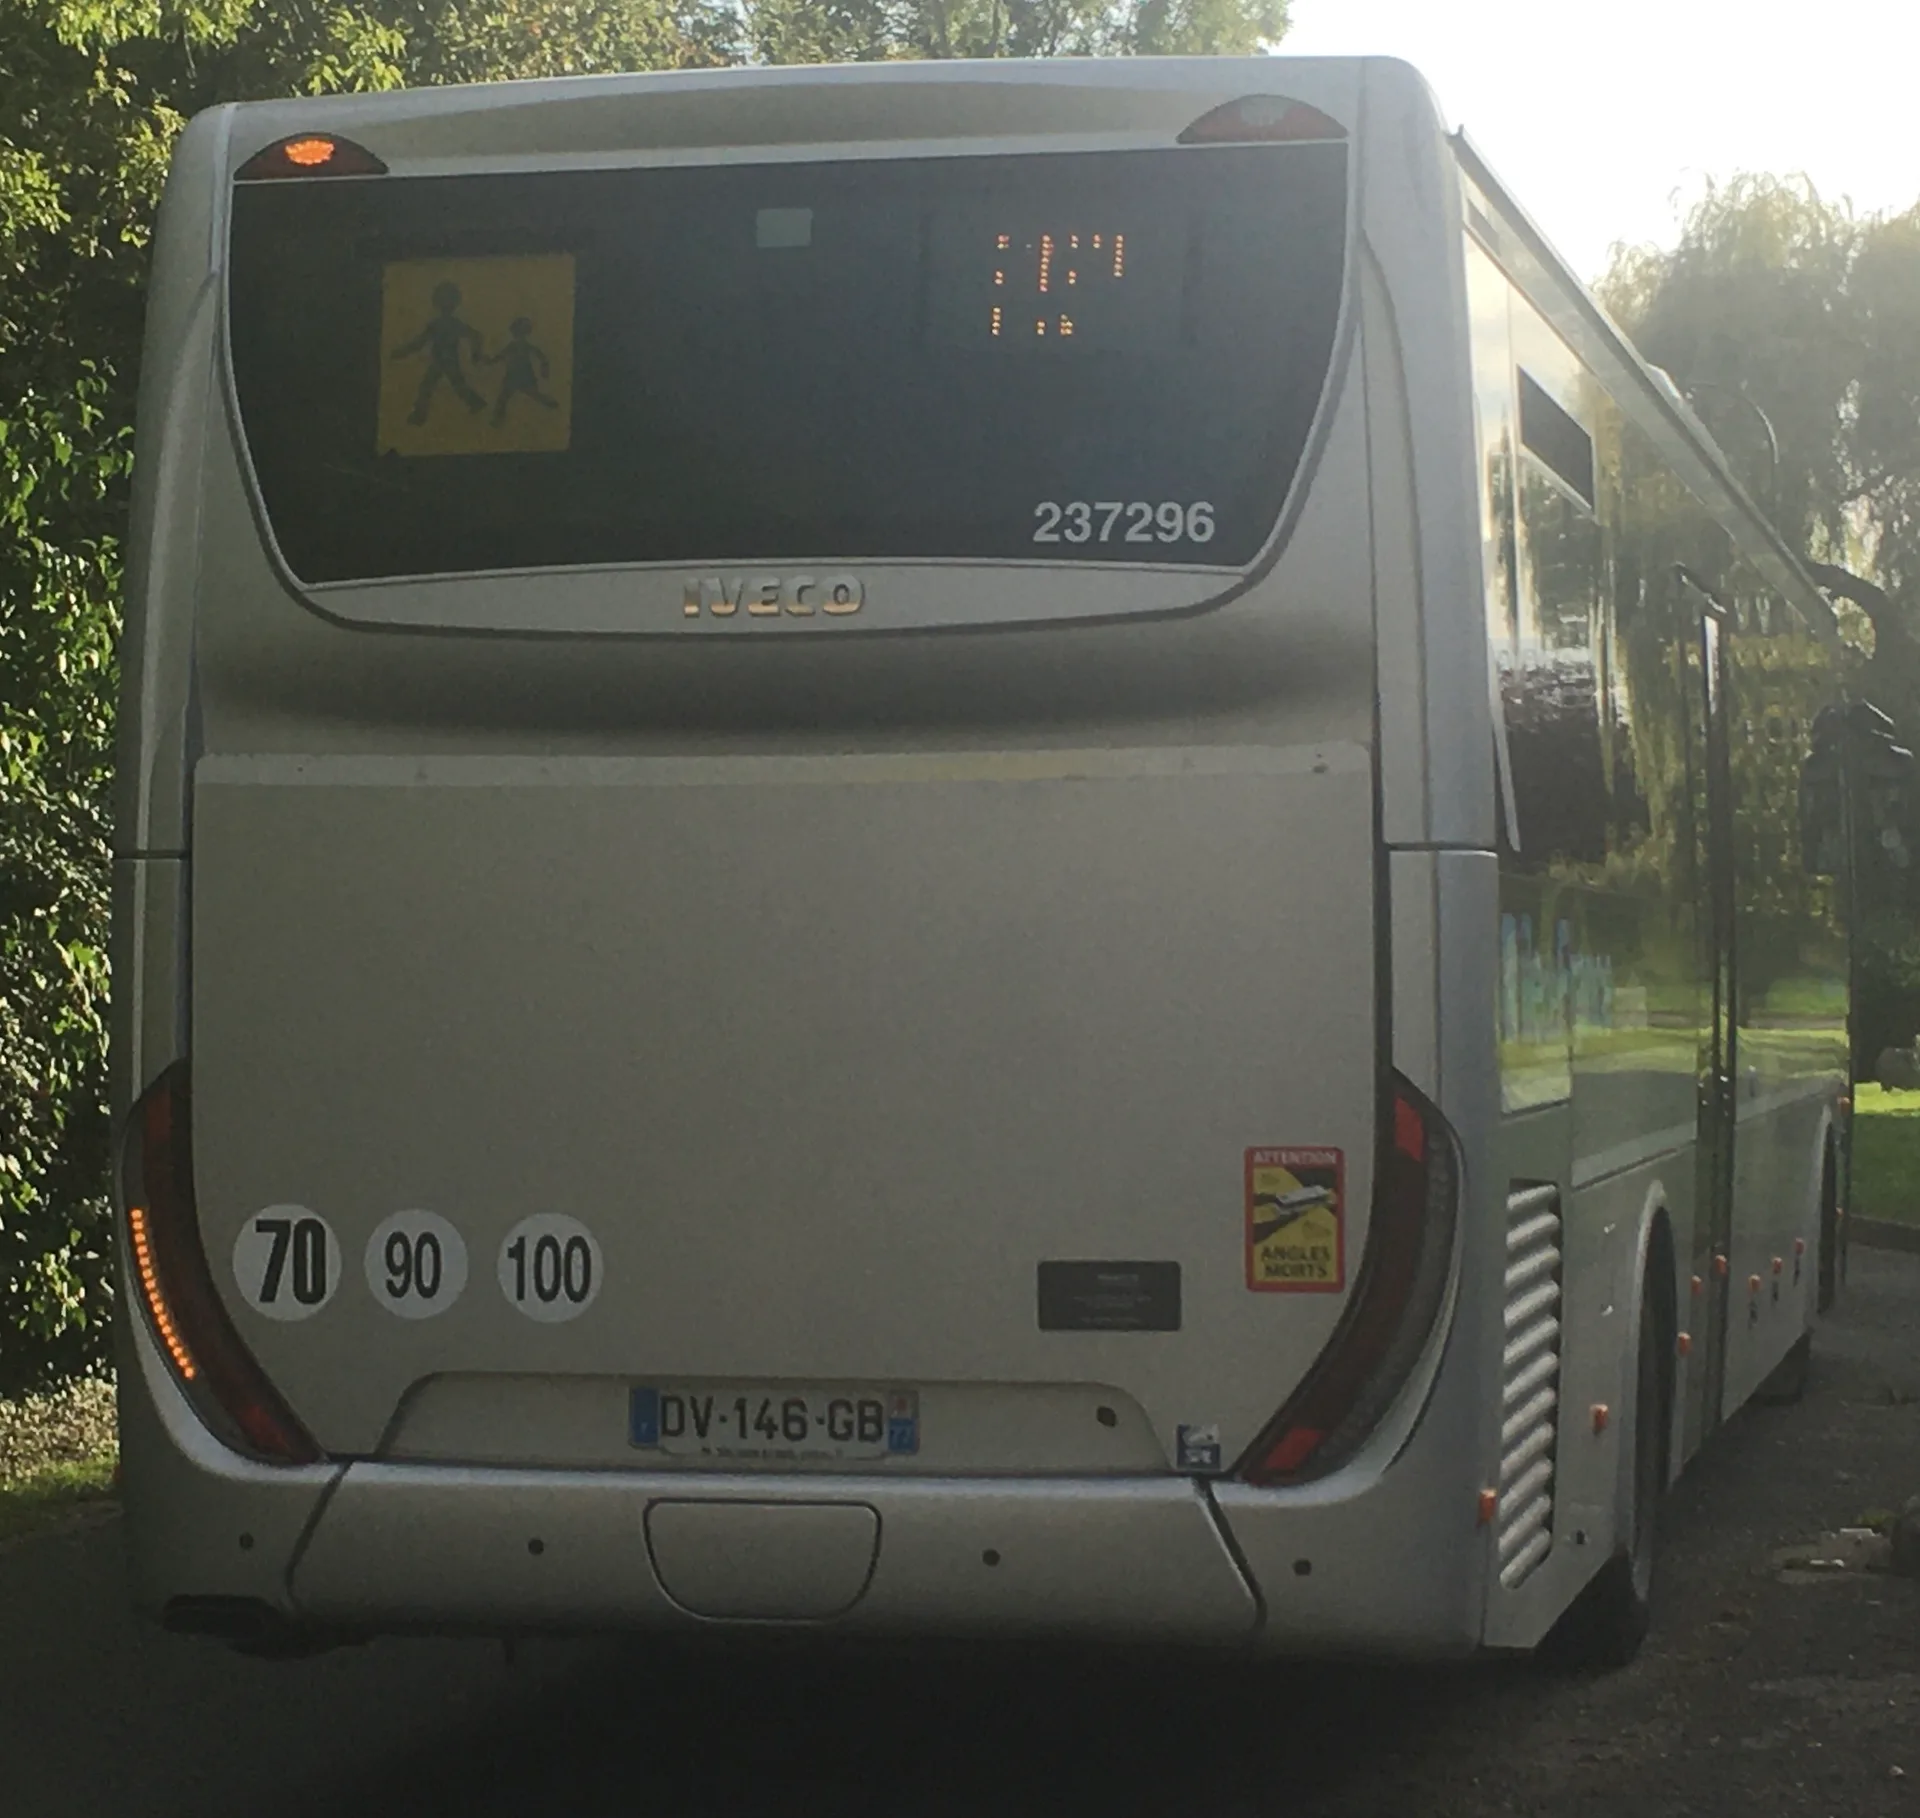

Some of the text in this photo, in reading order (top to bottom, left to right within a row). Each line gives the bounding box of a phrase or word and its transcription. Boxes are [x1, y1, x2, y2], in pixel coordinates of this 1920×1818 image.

[1032, 501, 1215, 543] 237296
[683, 573, 866, 617] IVECO
[1253, 1151, 1337, 1164] ATTENTION
[255, 1218, 327, 1304] 70
[385, 1231, 441, 1299] 90
[507, 1234, 592, 1303] 100
[1261, 1246, 1330, 1262] ANGLES
[1264, 1263, 1328, 1278] MORTS
